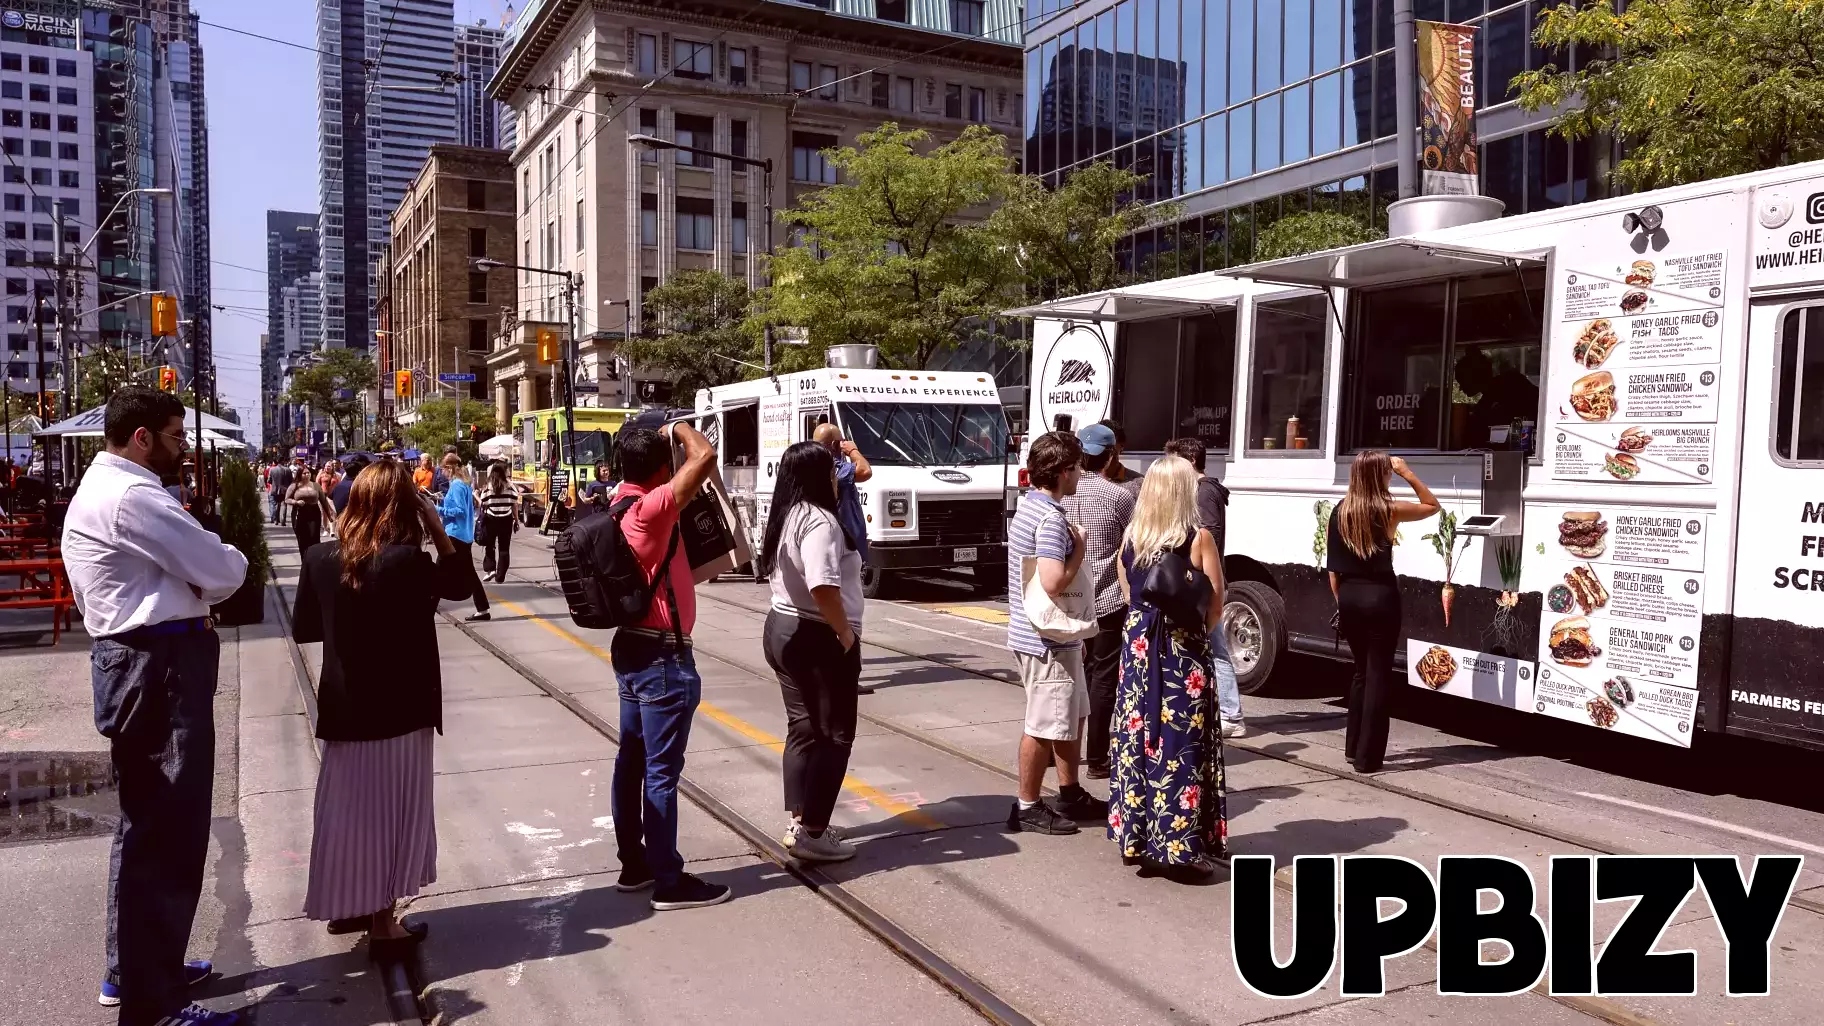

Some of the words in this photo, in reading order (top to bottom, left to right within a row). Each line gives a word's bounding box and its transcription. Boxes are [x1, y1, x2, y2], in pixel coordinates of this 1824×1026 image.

[25, 13, 76, 28] SPIN
[25, 22, 76, 36] MASTER
[1788, 228, 1824, 248] @HE
[1665, 256, 1693, 266] NASHVILLE
[1707, 252, 1722, 261] FRIED
[1693, 261, 1722, 270] SANDWICH
[1756, 248, 1824, 270] WWW.HEI
[1566, 284, 1587, 294] GENERAL
[1566, 292, 1590, 300] SANDWICH
[1632, 319, 1653, 329] HONEY
[1655, 316, 1679, 327] GARLIC
[1681, 315, 1701, 325] FRIED
[1632, 329, 1651, 338] FISH
[1659, 326, 1679, 336] TACOS
[1628, 374, 1664, 384] SZECHUAN
[1666, 373, 1685, 382] FRIED
[1702, 374, 1712, 383] $13
[836, 386, 917, 394] VENEZUELAN
[924, 388, 995, 396] EXPERIENCE
[1628, 384, 1655, 394] CHICKEN
[1657, 383, 1692, 392] SANDWICH
[1049, 389, 1100, 404] HEIRLOOM
[1376, 394, 1420, 410] ORDER
[1193, 406, 1212, 419] PICK
[1216, 406, 1227, 418] UP
[1198, 424, 1220, 435] HERE
[1380, 416, 1414, 430] HERE
[698, 516, 712, 530] ups
[1616, 516, 1637, 525] HONEY
[1639, 517, 1661, 526] GARLIC
[1663, 519, 1681, 528] FRIED
[1688, 522, 1698, 532] $13
[1616, 526, 1643, 535] CHICKEN
[1644, 528, 1678, 537] SANDWICH
[1614, 571, 1640, 582] BRISKET
[1642, 574, 1662, 584] BIRRIA
[1613, 581, 1638, 591] GRILLED
[1640, 584, 1664, 594] CHEESE
[1686, 582, 1697, 591] $14
[1610, 627, 1638, 639] GENERAL
[1641, 631, 1653, 641] TAO
[1655, 633, 1673, 644] PORK
[1609, 637, 1628, 647] BELLY
[1630, 640, 1665, 653] SANDWICH
[1681, 639, 1692, 648] $13
[1463, 657, 1479, 667] FRESH
[1480, 660, 1490, 669] CUT
[1491, 662, 1505, 672] FRIES
[1540, 679, 1555, 688] PULLED
[1568, 685, 1586, 694] POUTINE
[1660, 688, 1681, 698] KOREAN
[1537, 694, 1555, 704] ORIGINAL
[1557, 699, 1575, 708] POUTINE
[1639, 691, 1658, 701] PULLED
[1659, 695, 1674, 704] DUCK
[1675, 699, 1692, 708] TACOS
[1731, 690, 1800, 711] FARMERS
[1804, 701, 1824, 716] FE
